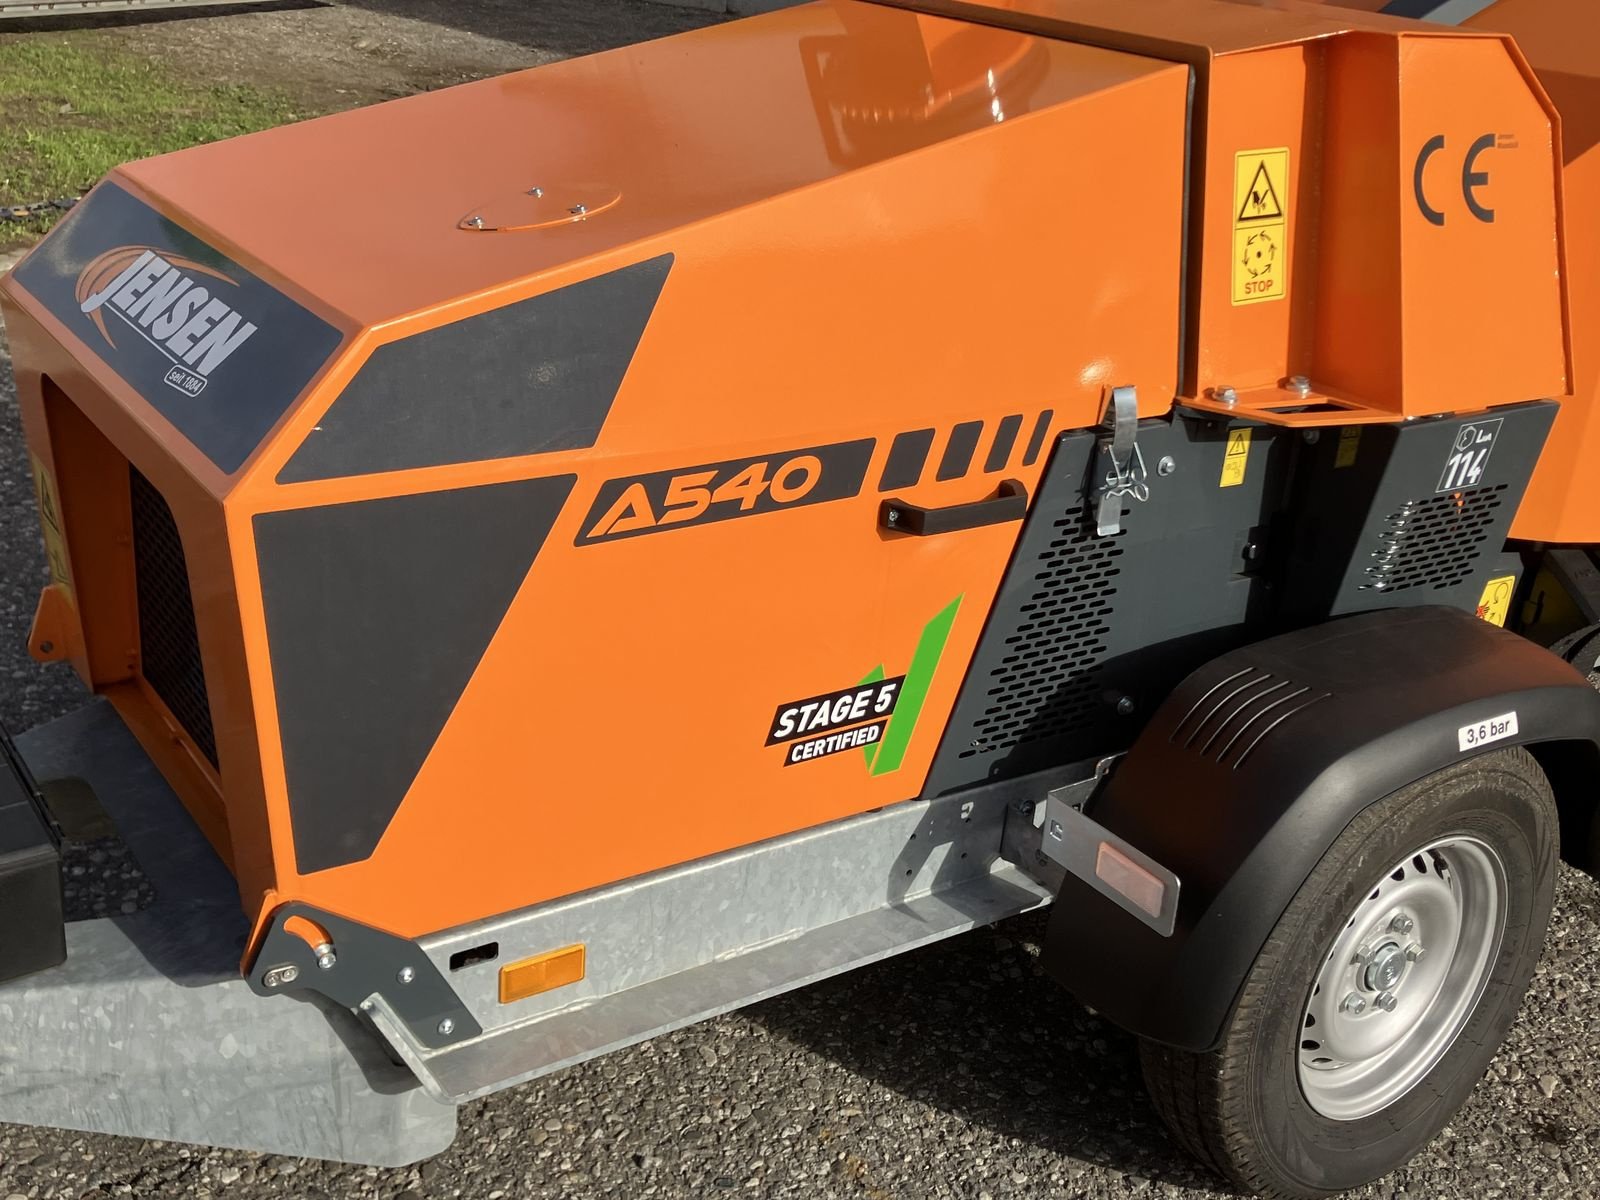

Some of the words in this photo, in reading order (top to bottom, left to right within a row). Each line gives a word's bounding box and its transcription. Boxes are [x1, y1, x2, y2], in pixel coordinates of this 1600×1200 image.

[1414, 133, 1496, 226] CE
[1245, 280, 1273, 294] STOP
[81, 250, 258, 376] JENSEN
[169, 371, 186, 384] seit
[183, 376, 203, 393] 1884
[1444, 448, 1488, 488] 114
[586, 455, 821, 538] A540
[774, 689, 874, 738] STAGE
[874, 683, 896, 713] 5
[791, 725, 880, 762] CERTIFIED
[1467, 725, 1486, 744] 3,6
[1490, 720, 1510, 736] bar
